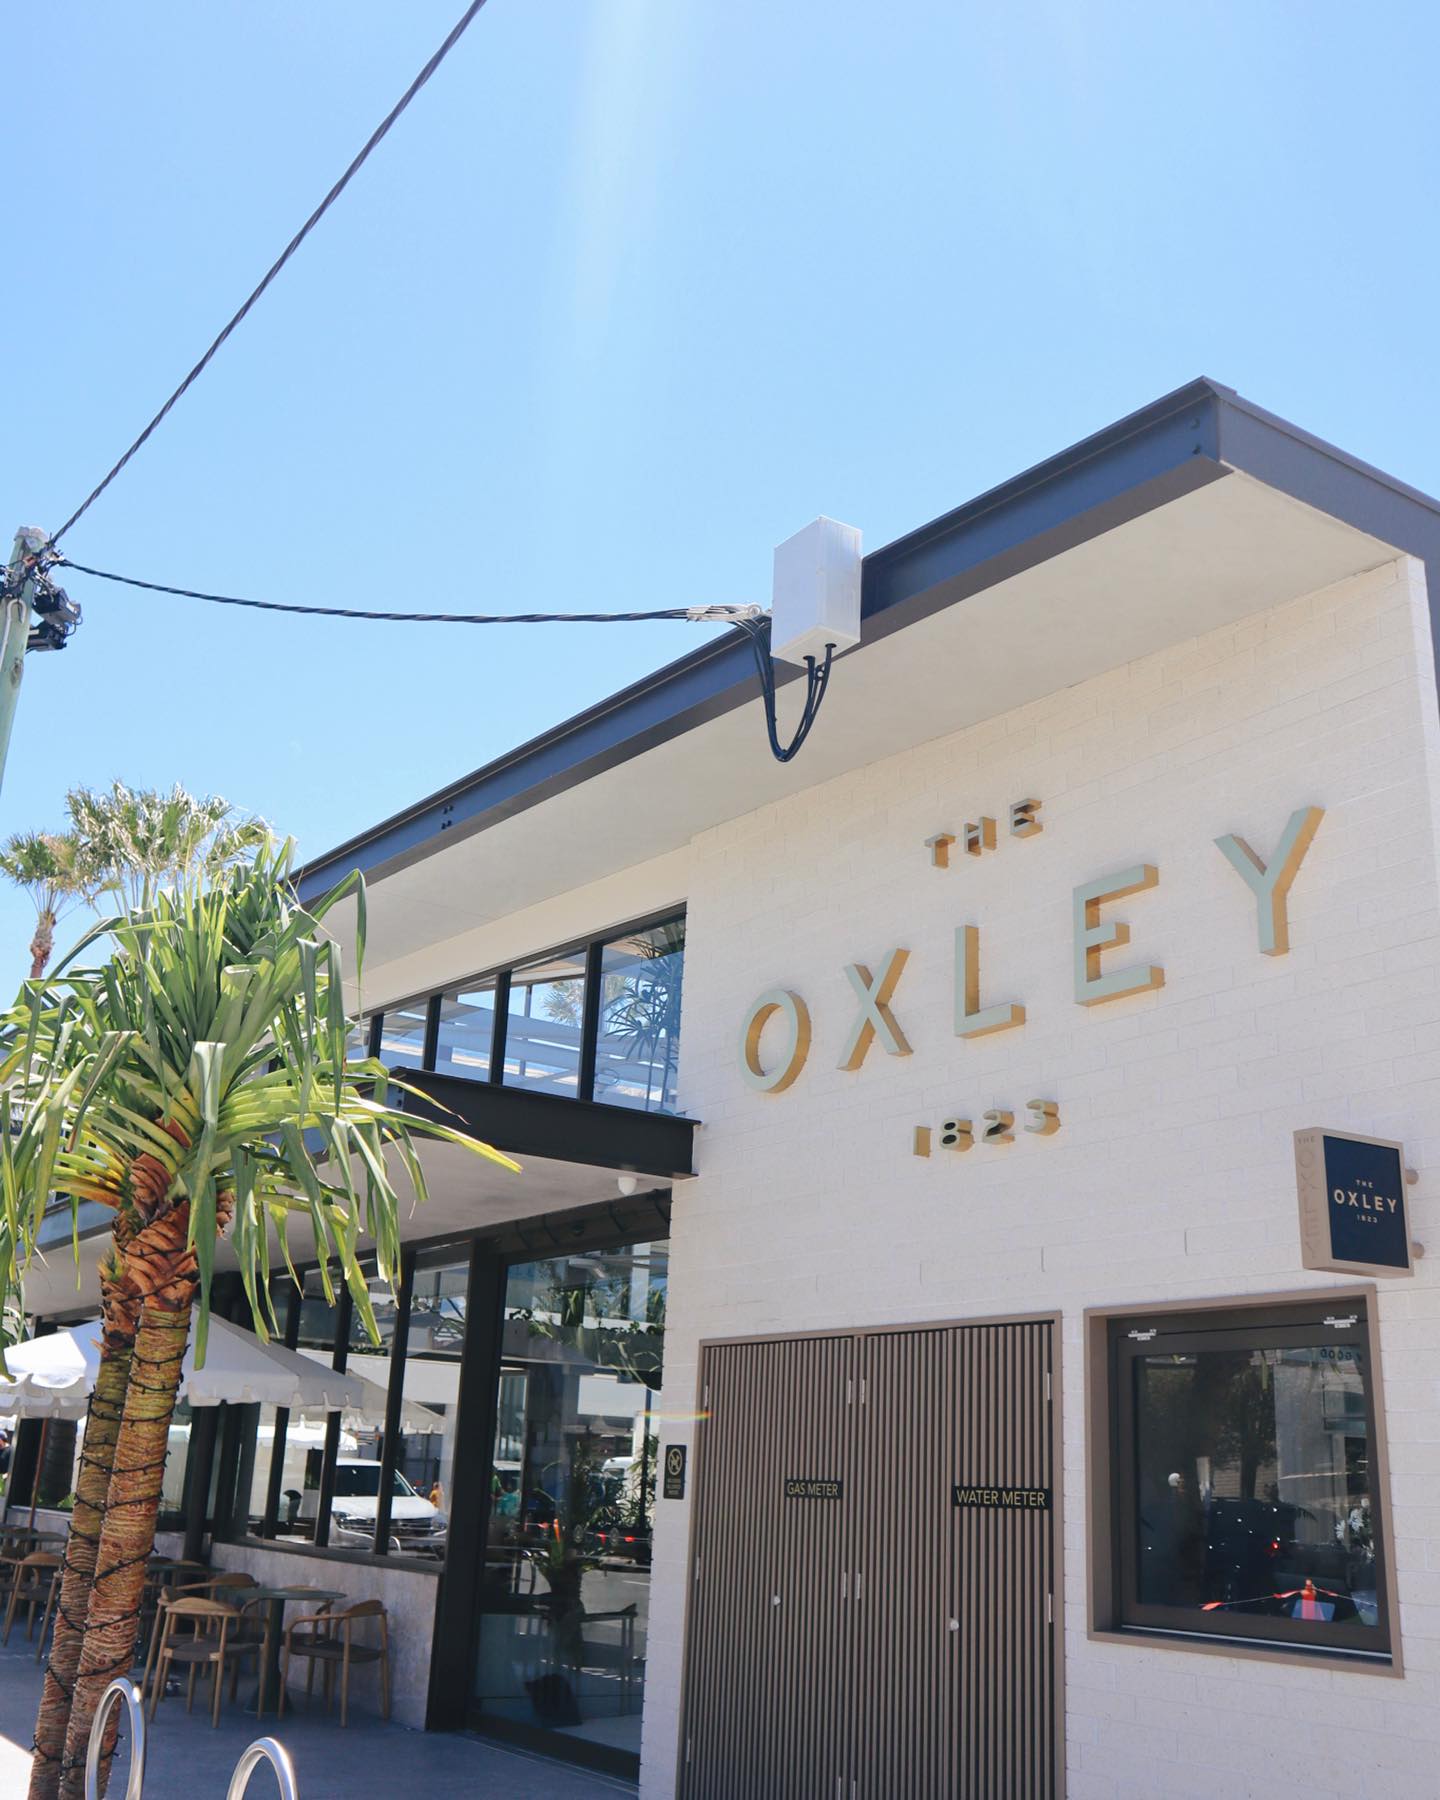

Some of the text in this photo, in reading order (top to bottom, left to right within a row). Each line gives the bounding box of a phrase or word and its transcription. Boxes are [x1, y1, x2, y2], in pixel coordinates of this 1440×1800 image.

[924, 798, 1043, 869] THE
[739, 806, 1325, 1094] OXLEY
[913, 1098, 1061, 1158] 1823
[1355, 1179, 1374, 1188] THE
[1333, 1188, 1397, 1213] OXLEY
[787, 1482, 839, 1496] GAS METER
[957, 1489, 1046, 1507] WATER METER
